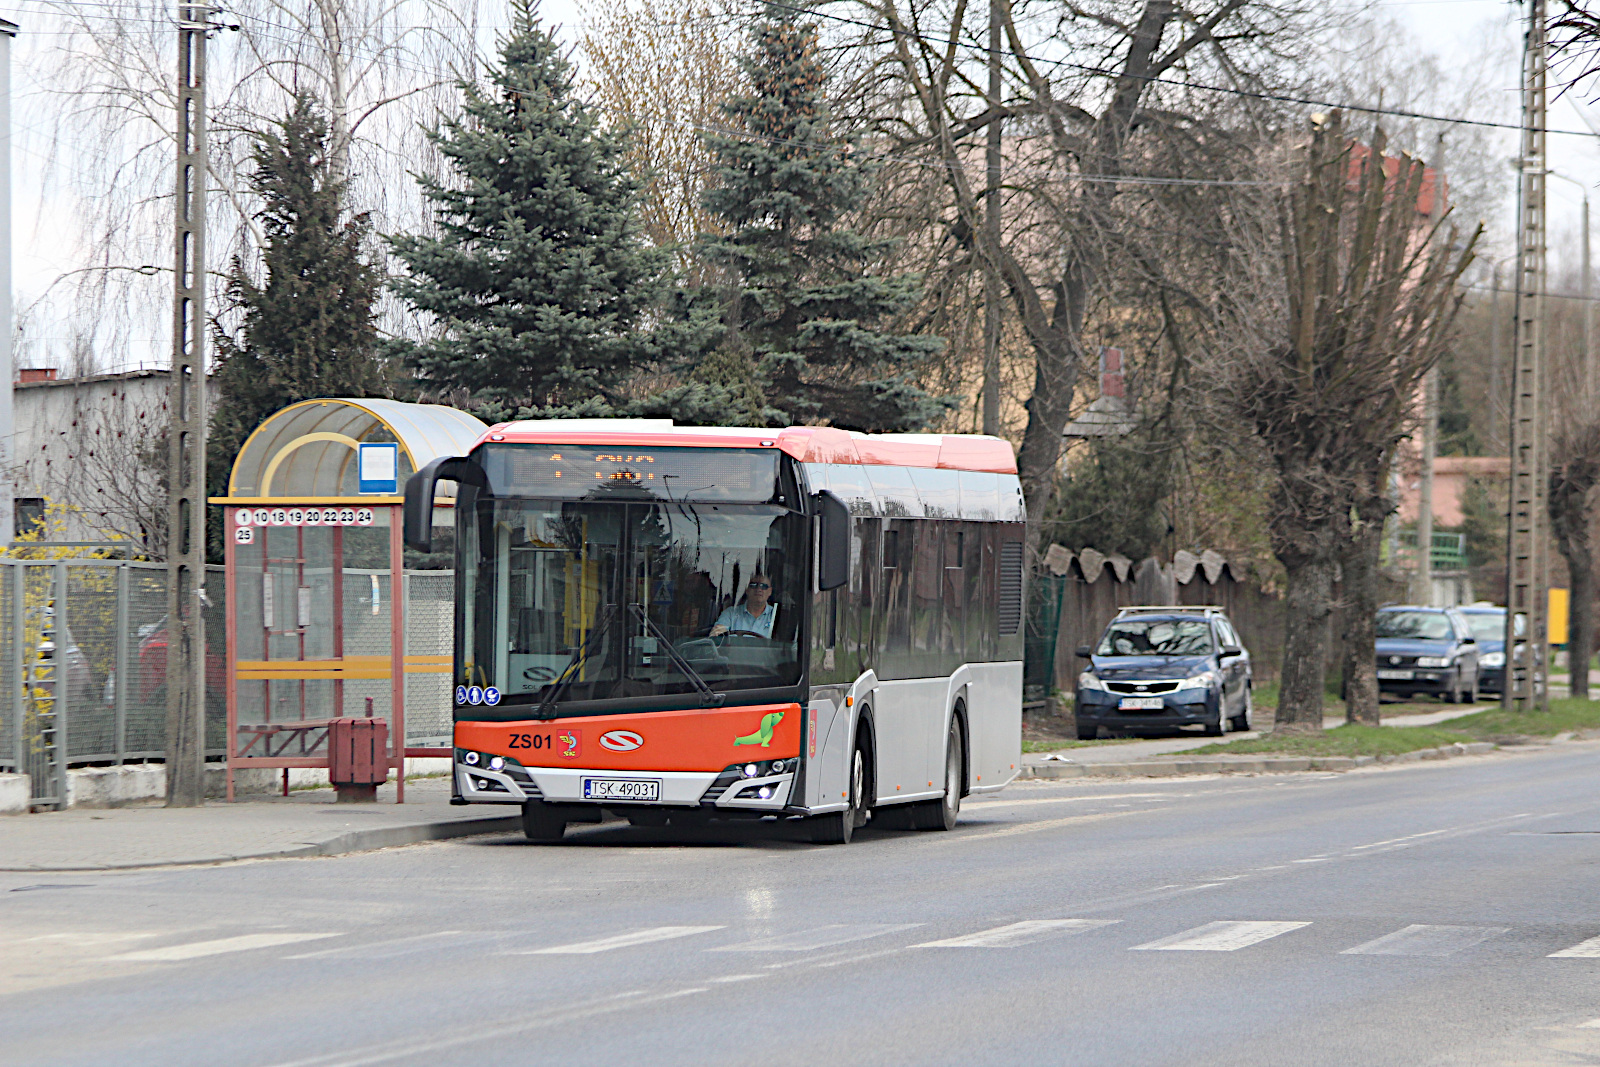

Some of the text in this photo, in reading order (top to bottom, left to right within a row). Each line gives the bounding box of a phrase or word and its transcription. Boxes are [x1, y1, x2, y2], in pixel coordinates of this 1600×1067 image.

[255, 512, 268, 521] 10
[272, 512, 285, 522] 18
[289, 512, 302, 522] 19
[306, 512, 320, 522] 20
[323, 512, 337, 522] 22
[340, 512, 354, 522] 23
[358, 512, 371, 522] 24
[237, 530, 251, 540] 25
[508, 734, 551, 749] ZS01
[592, 782, 655, 796] TSK 49031
